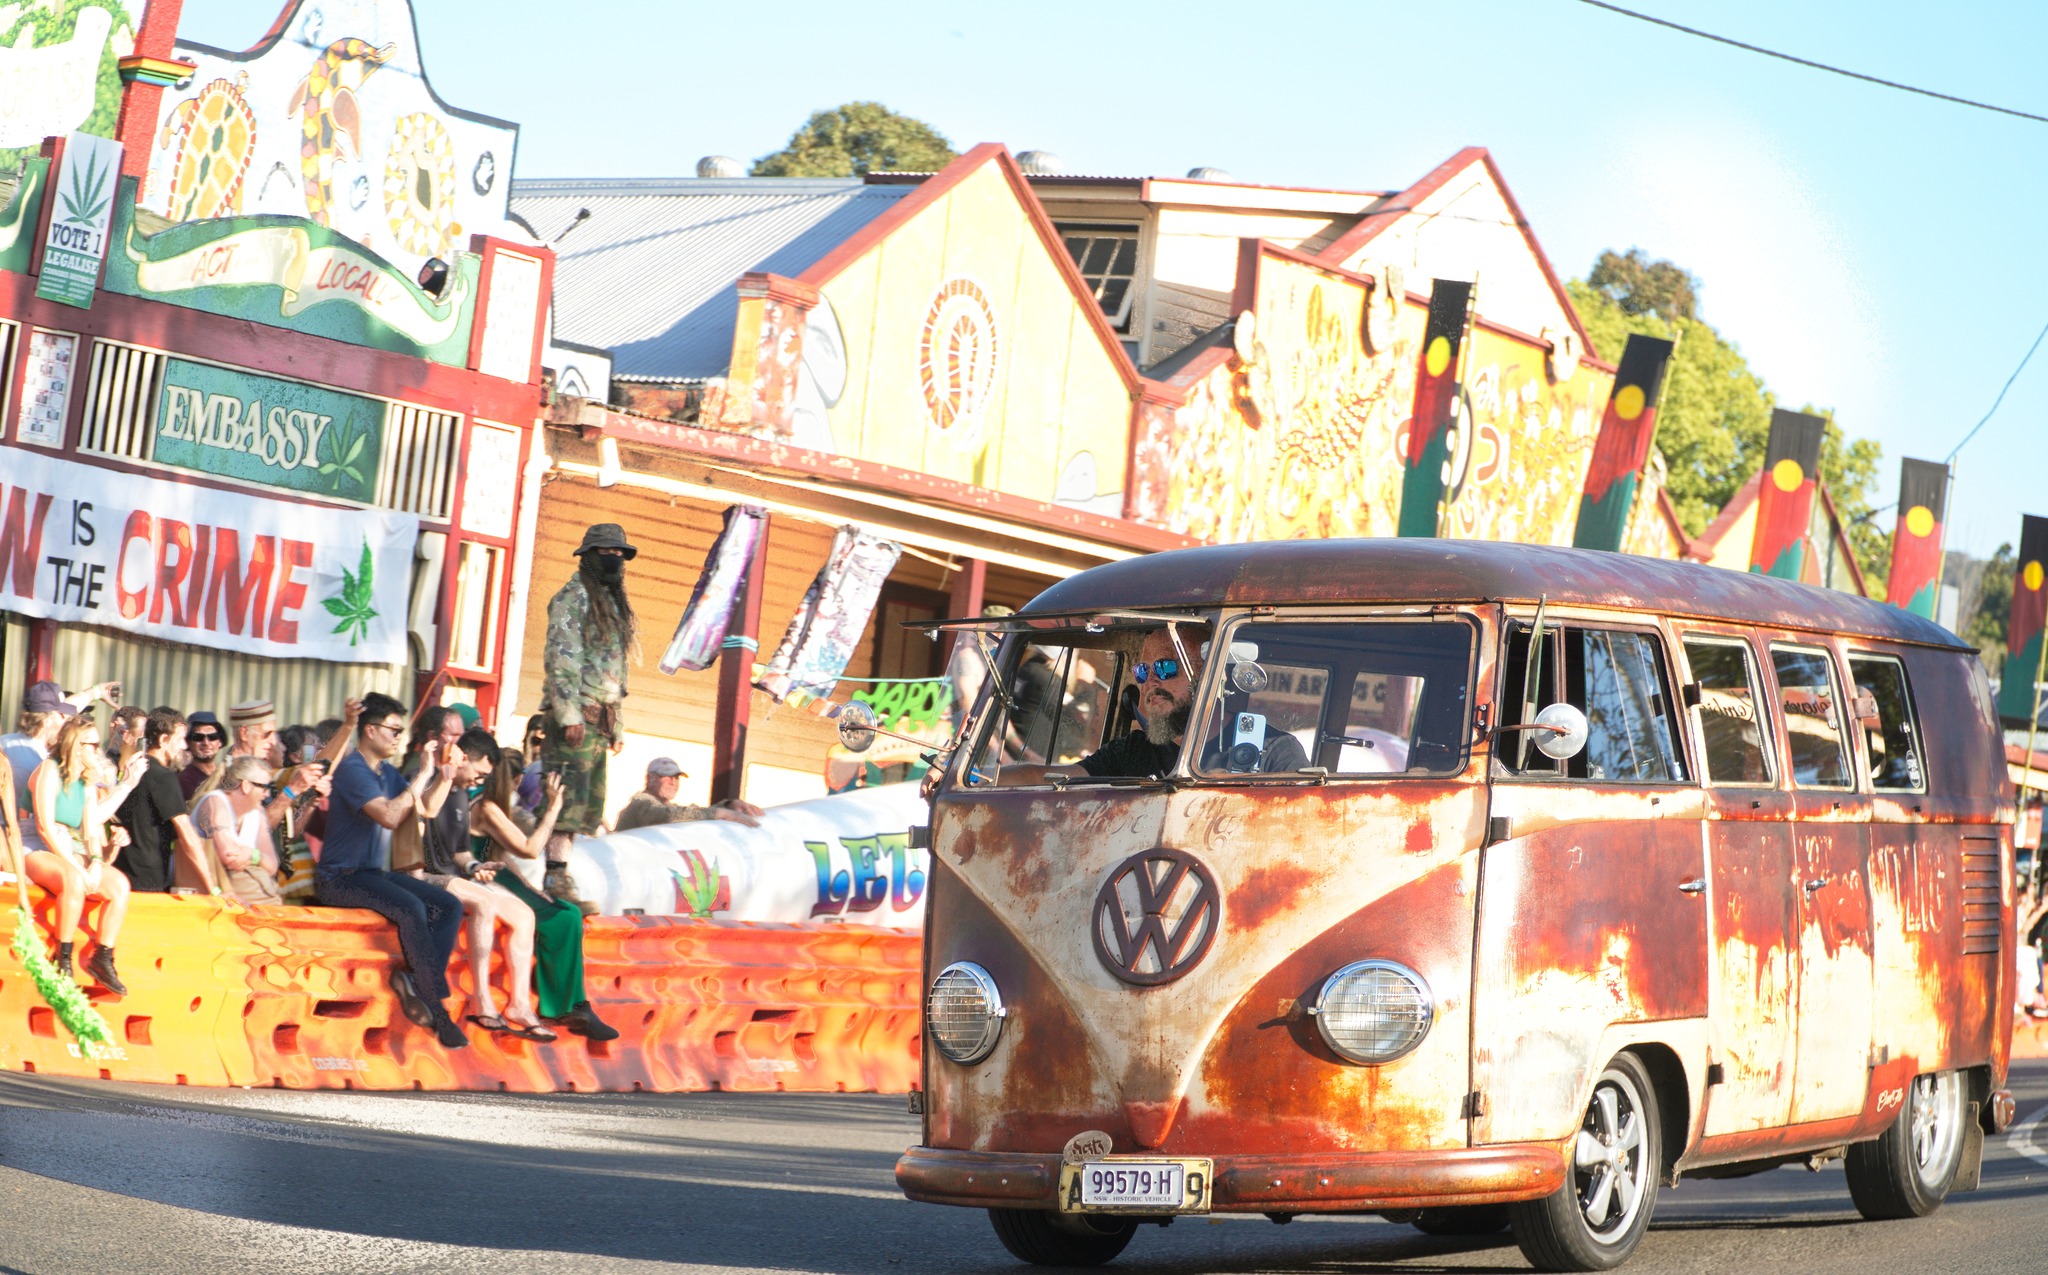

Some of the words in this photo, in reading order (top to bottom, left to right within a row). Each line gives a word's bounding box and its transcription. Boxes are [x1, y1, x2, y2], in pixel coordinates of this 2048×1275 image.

[52, 222, 91, 251] VOTE
[45, 249, 99, 275] LEGALISE
[190, 244, 240, 282] ACT
[159, 384, 333, 470] EMBASSY
[71, 499, 95, 546] IS
[47, 556, 106, 609] THE
[116, 509, 314, 644] CRIME
